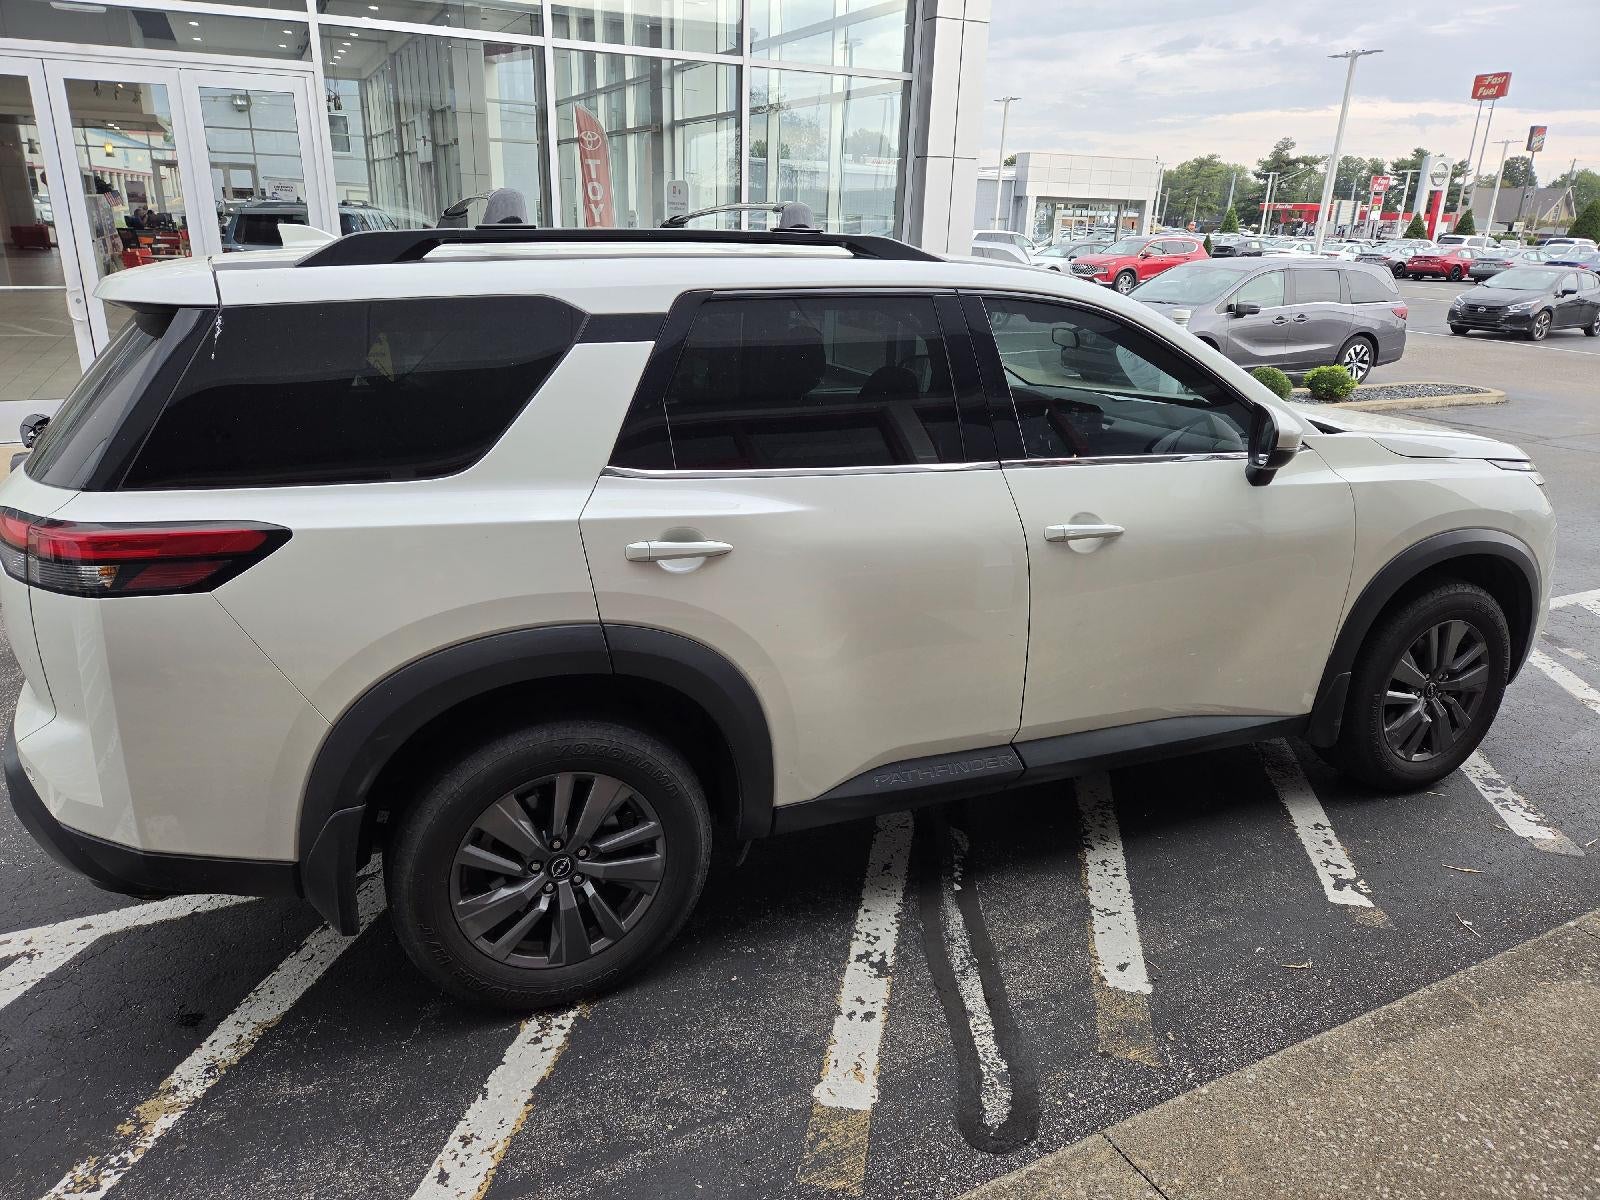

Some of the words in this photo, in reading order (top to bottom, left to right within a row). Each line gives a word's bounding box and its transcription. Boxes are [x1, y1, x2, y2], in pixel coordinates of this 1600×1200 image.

[1486, 75, 1506, 84] Fast
[1477, 86, 1498, 96] Fuel
[872, 754, 1014, 785] PATHFINDER
